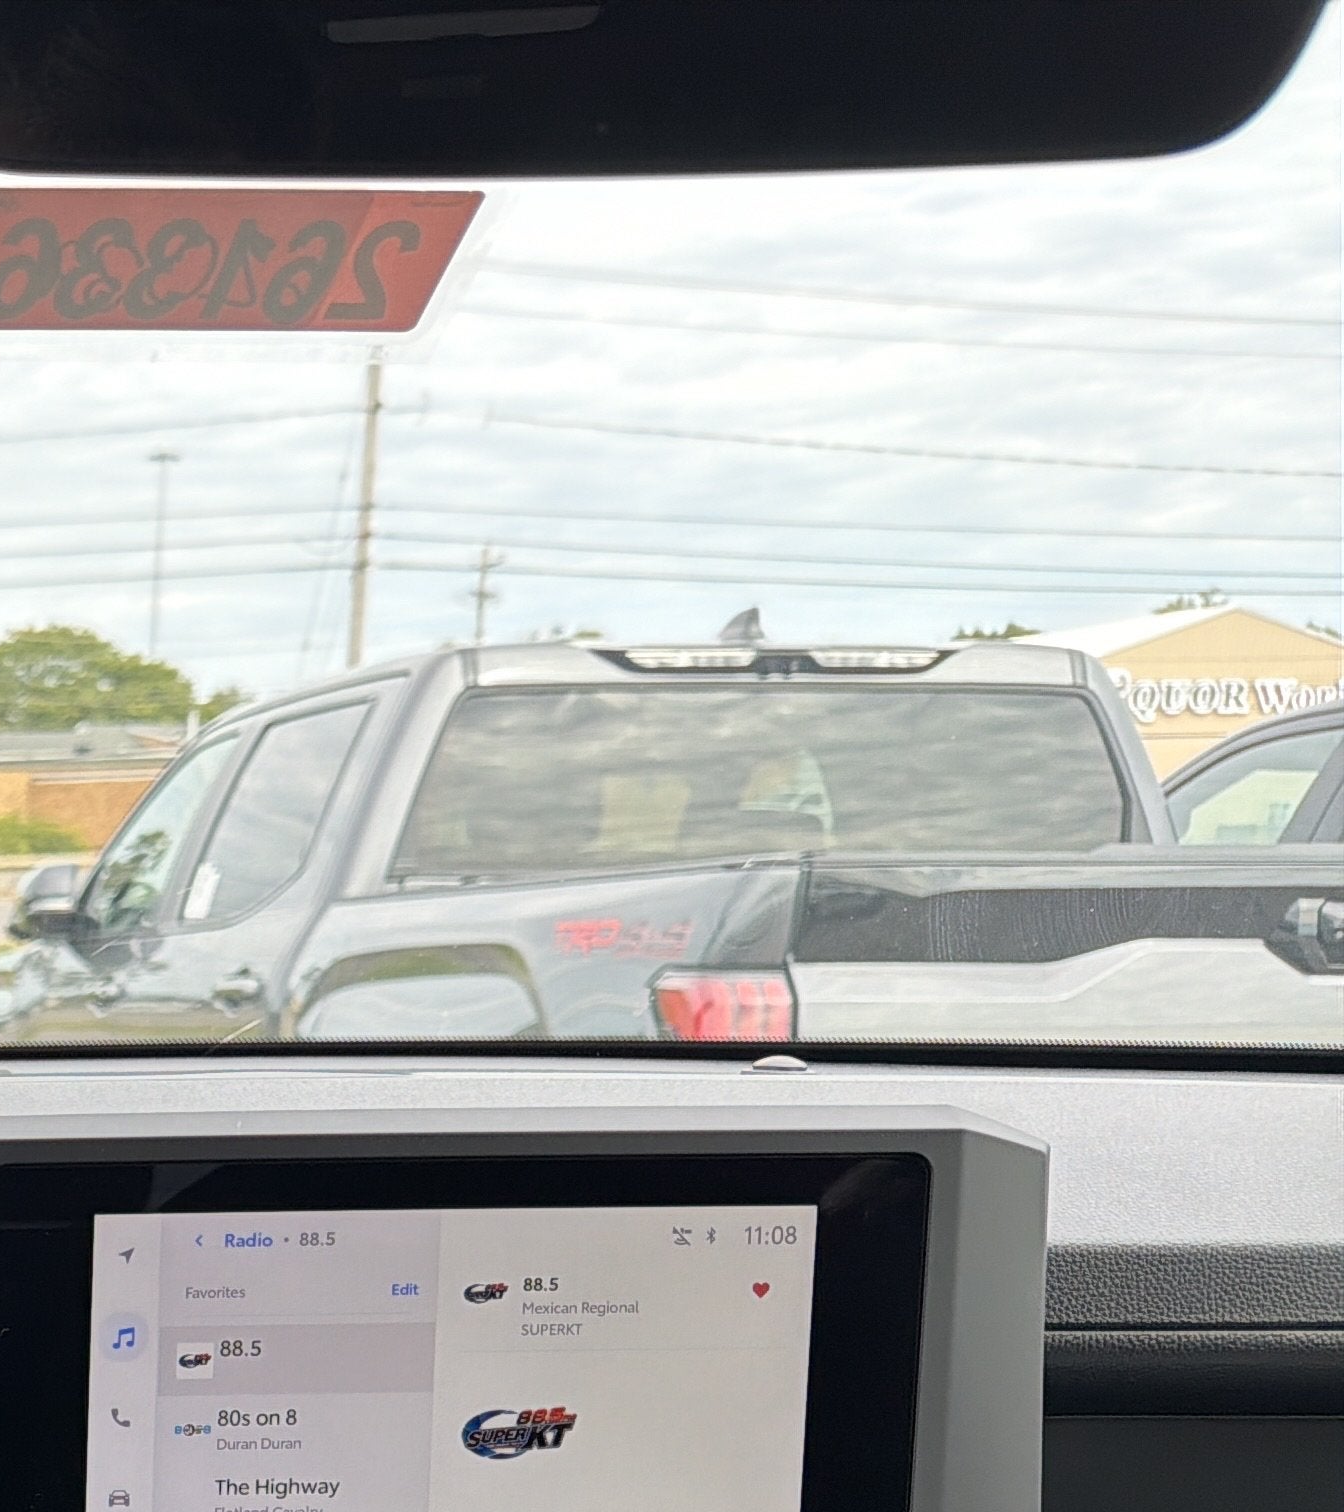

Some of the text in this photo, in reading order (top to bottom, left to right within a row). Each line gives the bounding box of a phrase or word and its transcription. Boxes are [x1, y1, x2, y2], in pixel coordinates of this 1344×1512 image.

[1107, 666, 1250, 724] QUOR
[224, 1232, 336, 1248] Radio 88.5
[744, 1226, 797, 1245] 11:08
[185, 1283, 419, 1299] Favorites Edit
[523, 1277, 559, 1292] 88.5
[522, 1301, 639, 1316] Mexican Regional
[521, 1323, 582, 1337] SUPERKT
[220, 1340, 262, 1357] 88.5
[218, 1409, 297, 1427] 80s on 8
[216, 1437, 302, 1451] Duran Duran
[215, 1478, 340, 1498] The Highway
